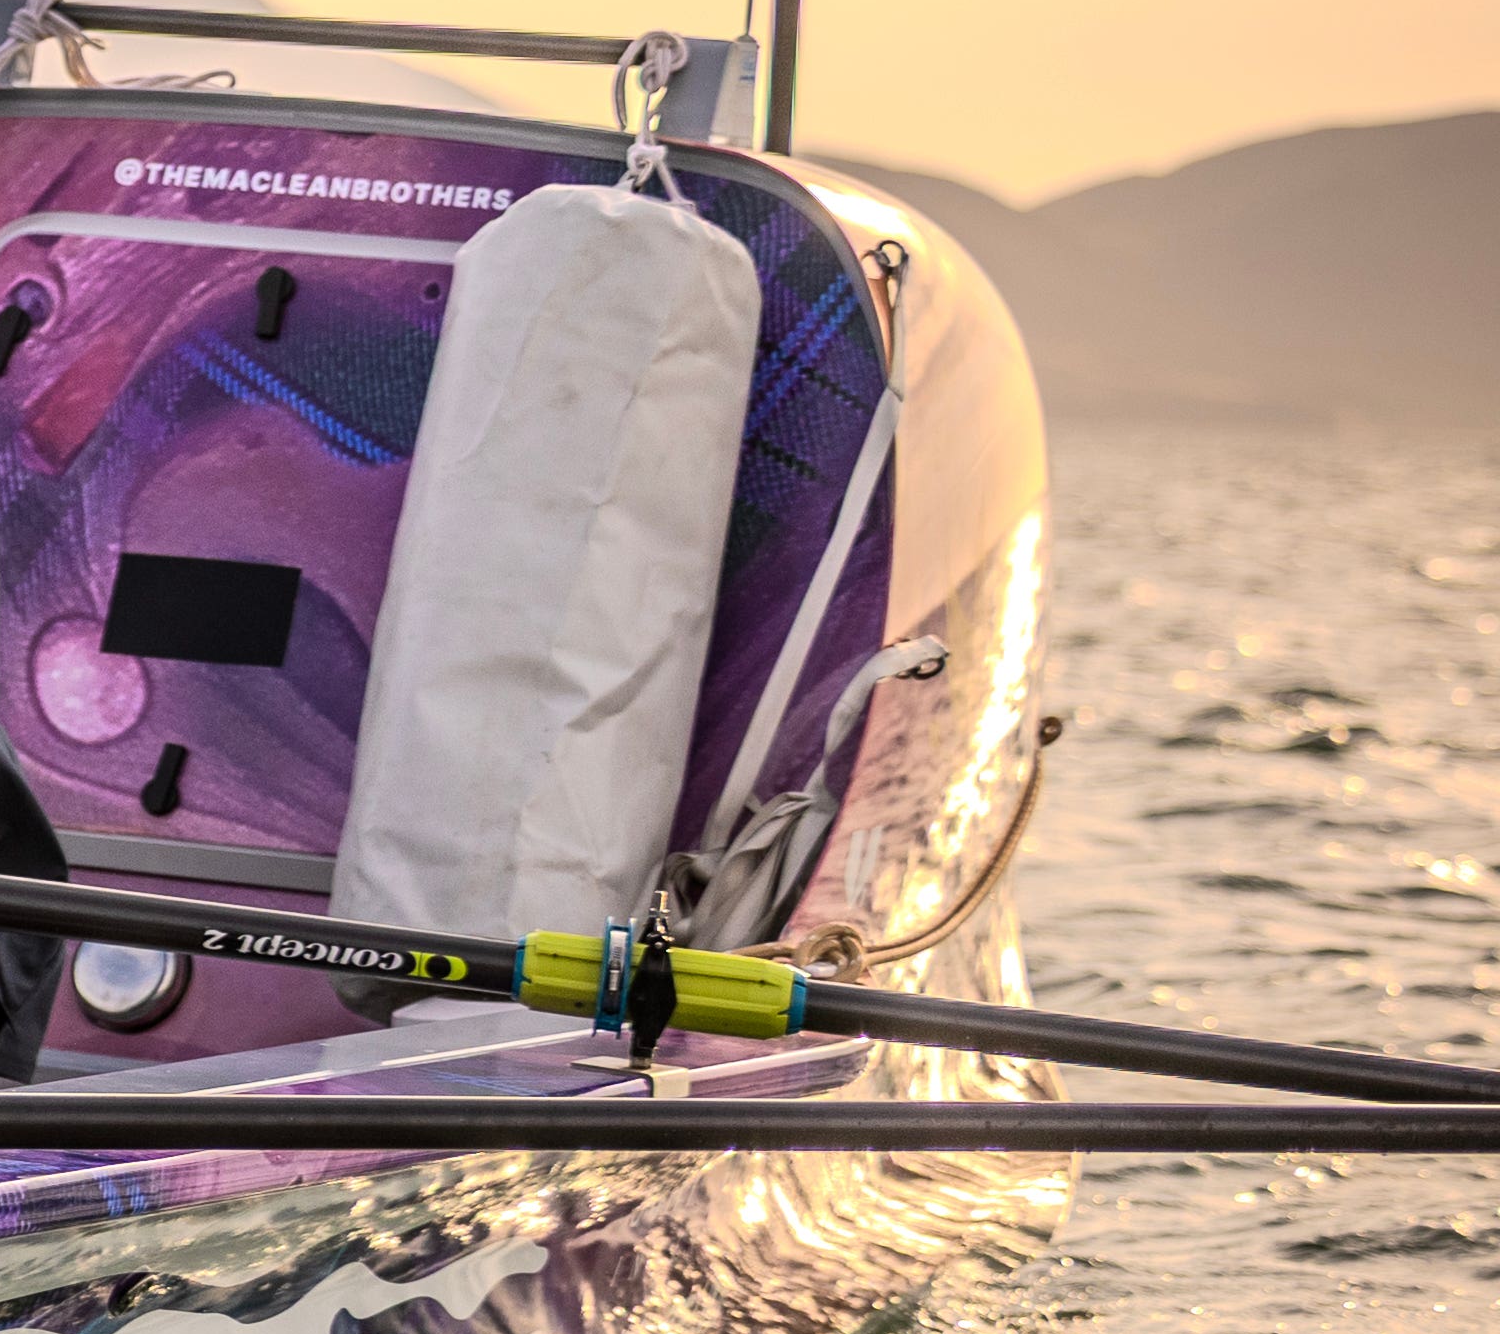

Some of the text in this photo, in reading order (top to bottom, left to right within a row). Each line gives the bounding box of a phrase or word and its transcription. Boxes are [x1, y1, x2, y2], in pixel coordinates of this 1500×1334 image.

[114, 157, 515, 211] @THEMACLEANBROTHERS
[202, 928, 403, 971] concept 2
